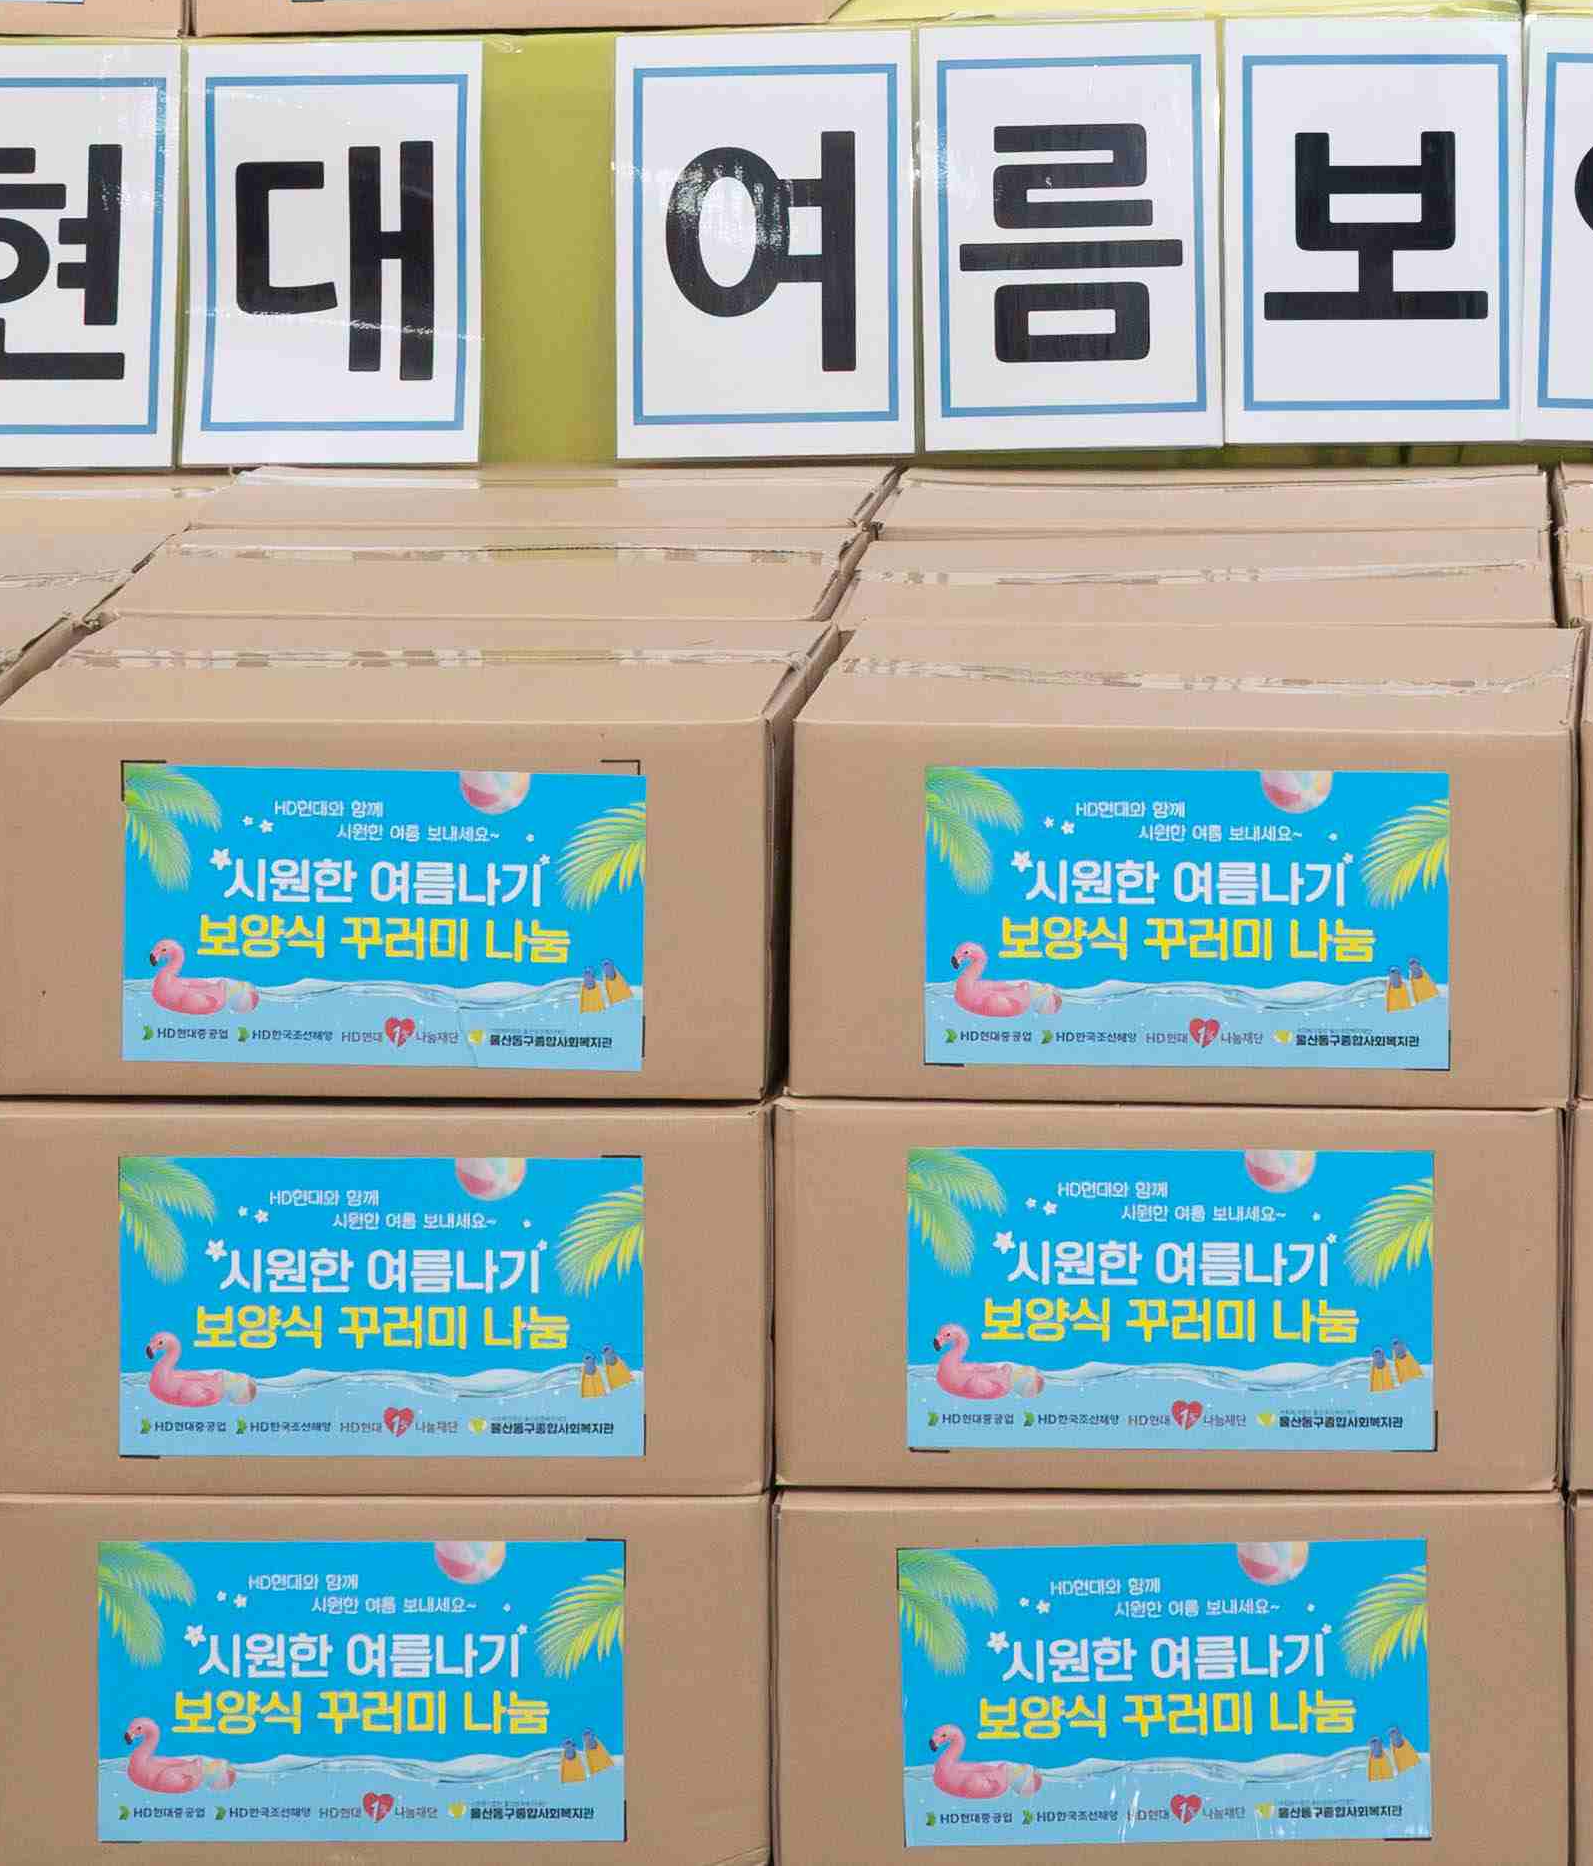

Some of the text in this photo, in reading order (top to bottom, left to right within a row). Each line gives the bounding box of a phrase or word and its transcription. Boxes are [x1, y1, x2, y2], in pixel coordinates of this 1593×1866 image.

[1007, 1240, 1329, 1287] 시원한 여름나기
[981, 1297, 1360, 1344] 보양식 꾸러미 나눔
